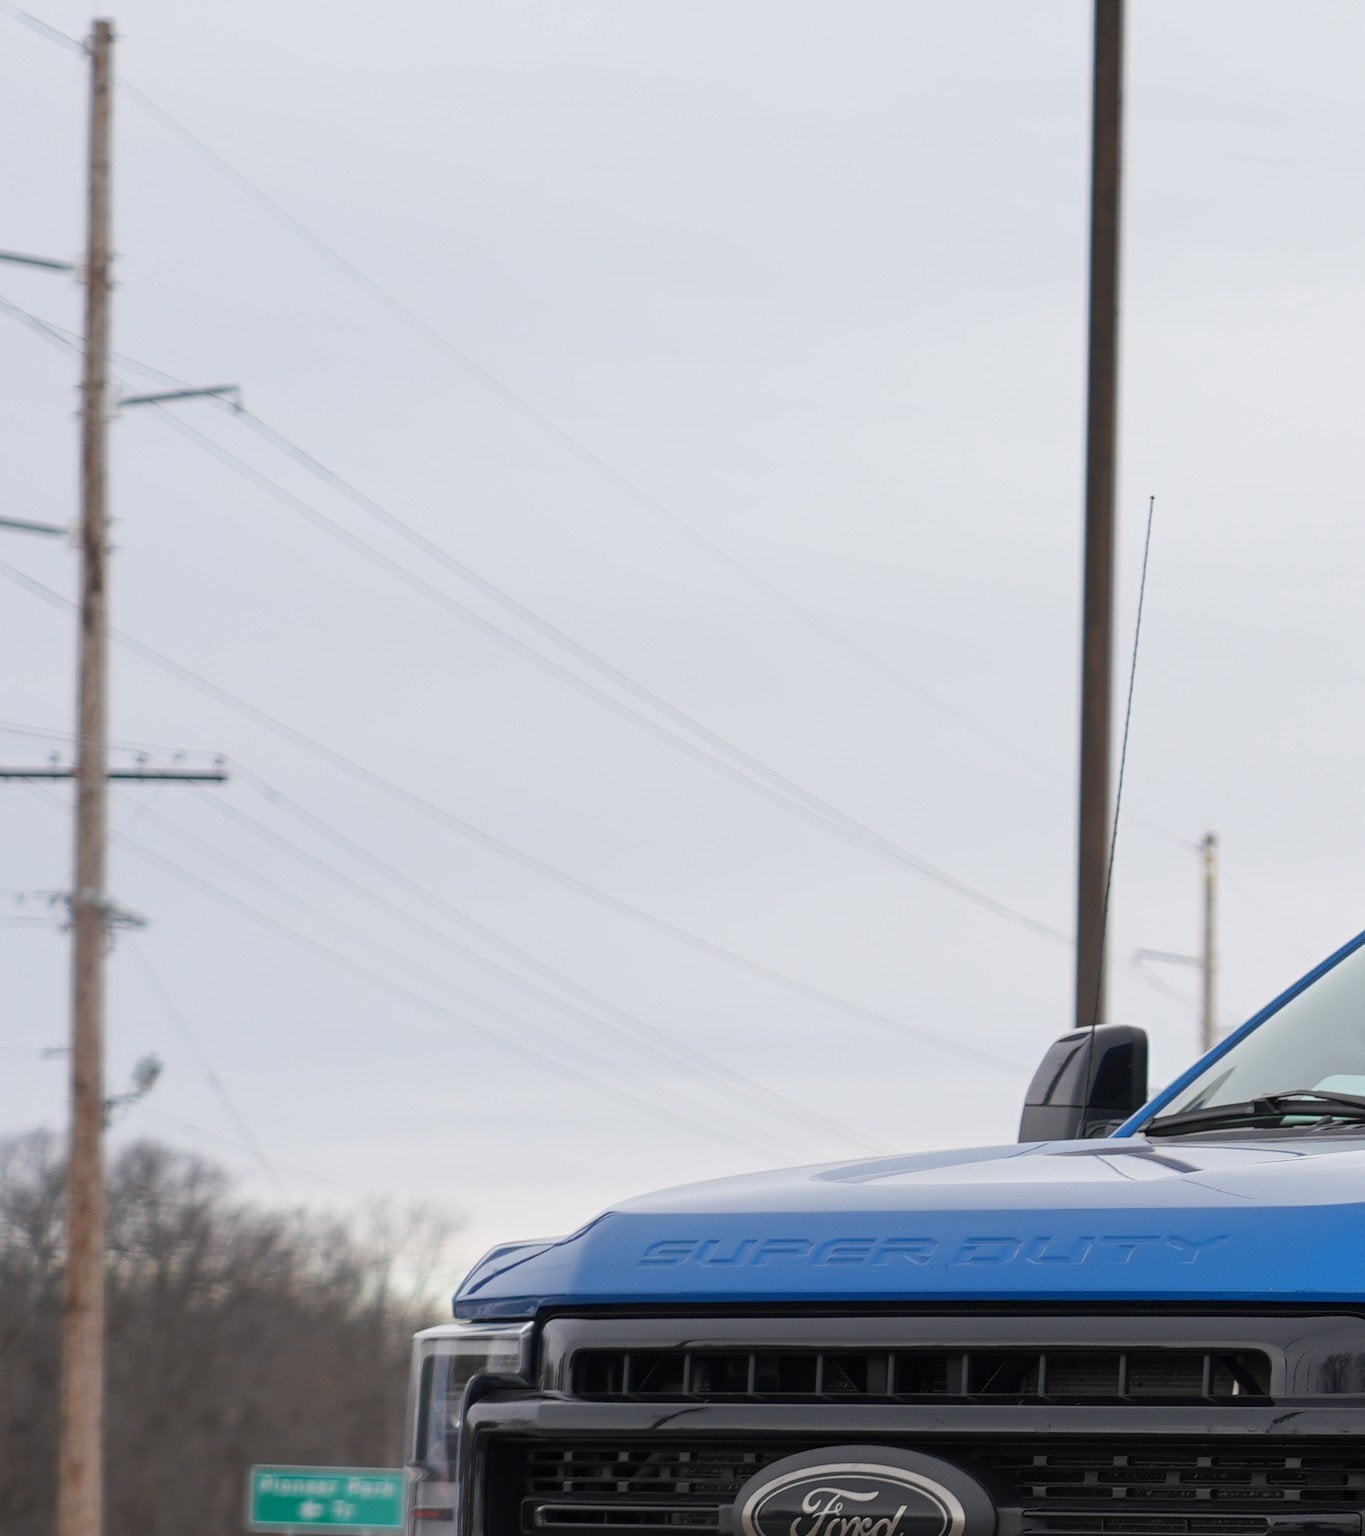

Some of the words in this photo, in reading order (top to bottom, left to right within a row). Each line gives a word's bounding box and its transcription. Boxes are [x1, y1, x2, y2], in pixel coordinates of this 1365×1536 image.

[636, 1236, 940, 1268] SUPER
[953, 1234, 1229, 1267] DUTY
[347, 1476, 395, 1497] Park
